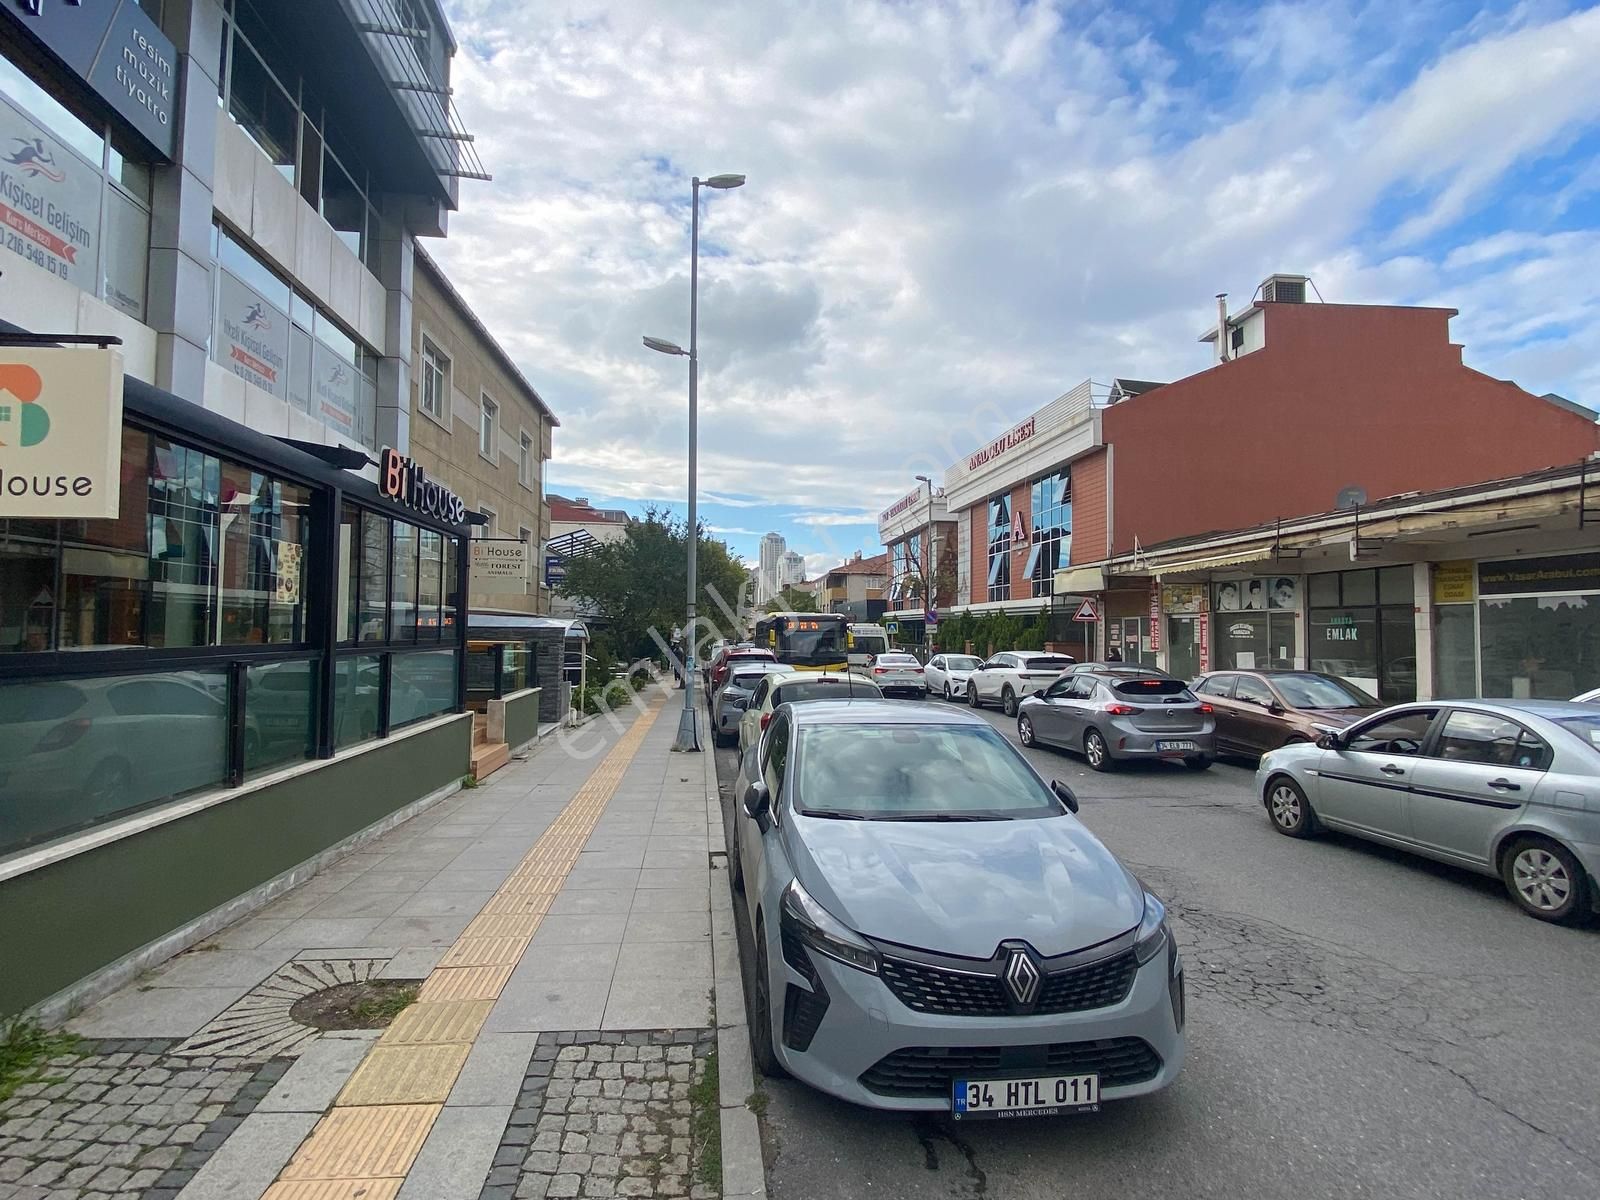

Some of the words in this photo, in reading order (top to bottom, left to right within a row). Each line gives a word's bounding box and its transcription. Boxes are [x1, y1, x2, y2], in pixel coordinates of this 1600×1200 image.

[123, 46, 169, 101] müzik
[132, 28, 171, 77] resim
[116, 64, 168, 125] tiyatro
[47, 203, 90, 249] Gelişim
[7, 233, 24, 256] 216
[27, 245, 44, 268] 548
[47, 255, 56, 274] 15
[59, 262, 68, 281] 19
[969, 438, 1006, 471] ANADOLU
[1007, 416, 1035, 449] LİSESİ
[0, 468, 92, 496] ouse
[1326, 628, 1358, 640] EMLAK
[956, 1098, 966, 1106] TR
[968, 1084, 994, 1108] 34
[1006, 1081, 1046, 1106] HTL
[1055, 1078, 1092, 1103] 011
[1015, 1107, 1058, 1117] MERCEDES
